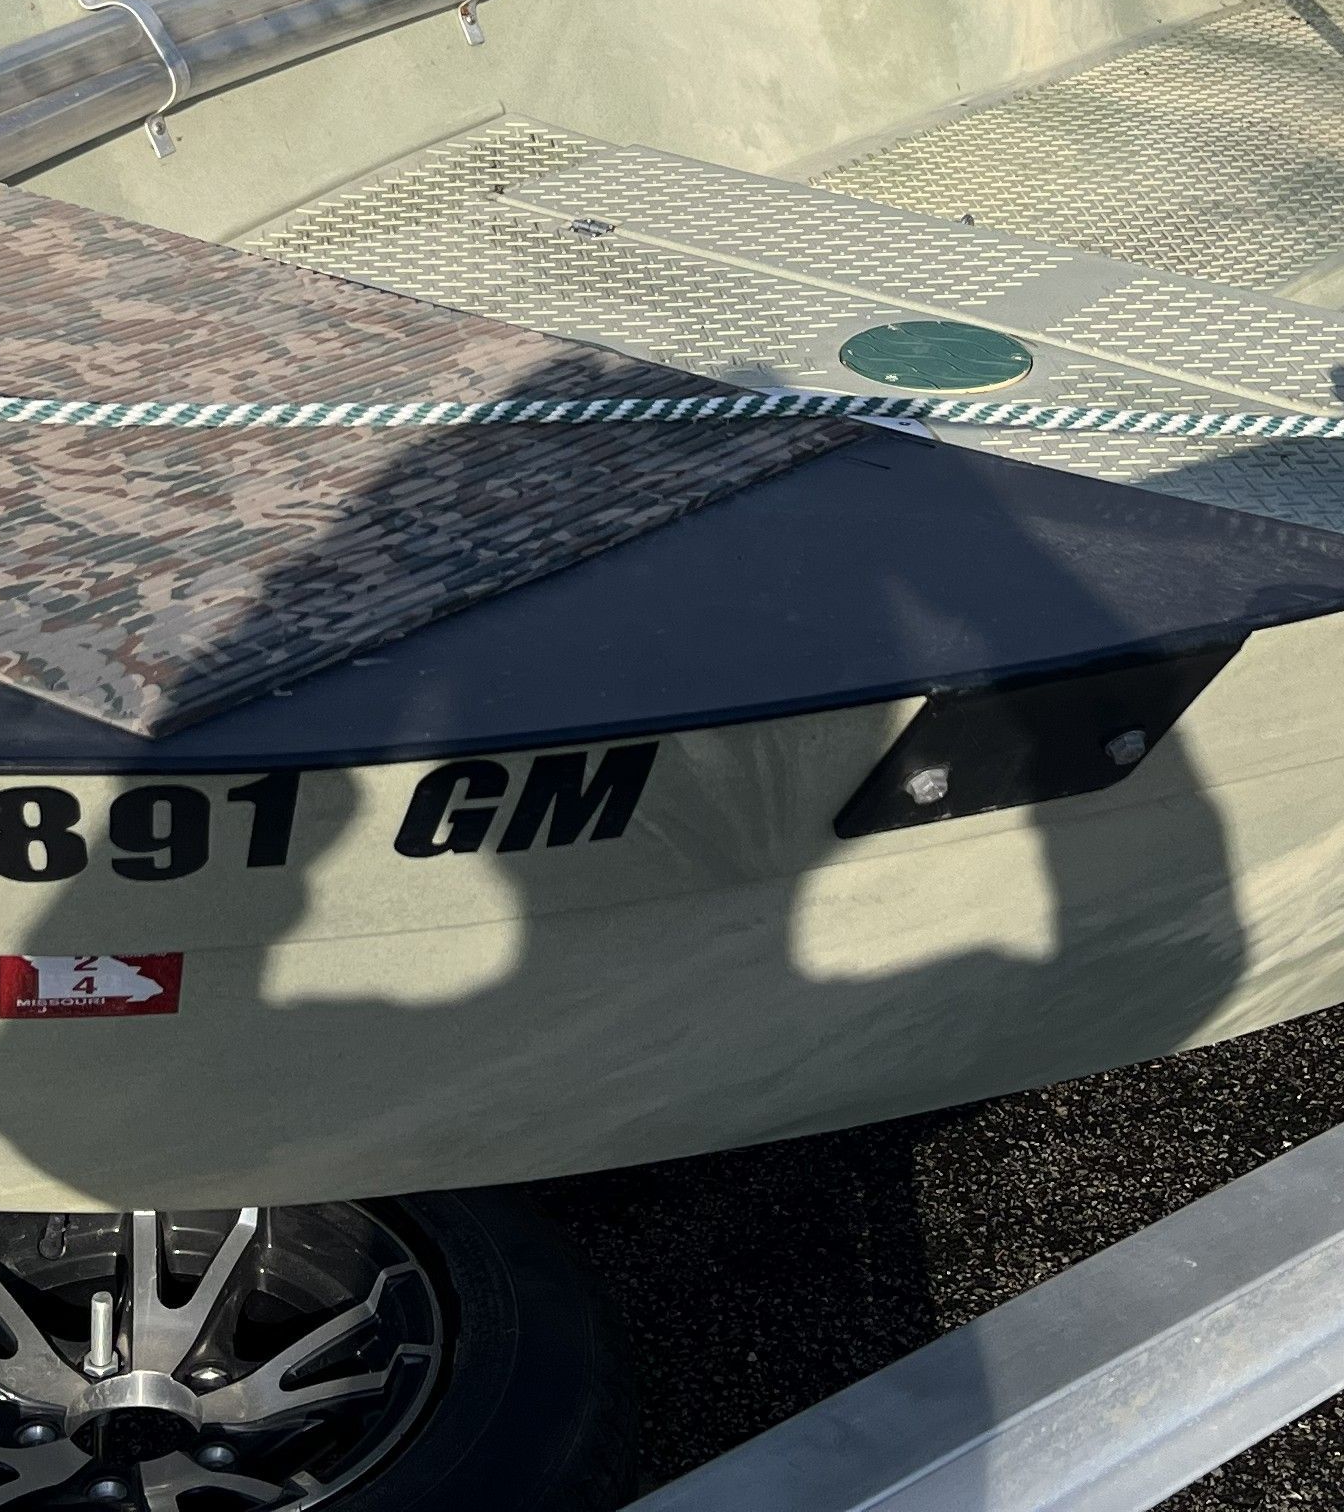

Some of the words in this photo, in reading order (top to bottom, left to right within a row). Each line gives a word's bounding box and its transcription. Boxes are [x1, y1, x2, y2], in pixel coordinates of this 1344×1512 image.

[394, 741, 659, 858] GM
[72, 975, 98, 995] 4
[17, 997, 106, 1008] MISSOURI
